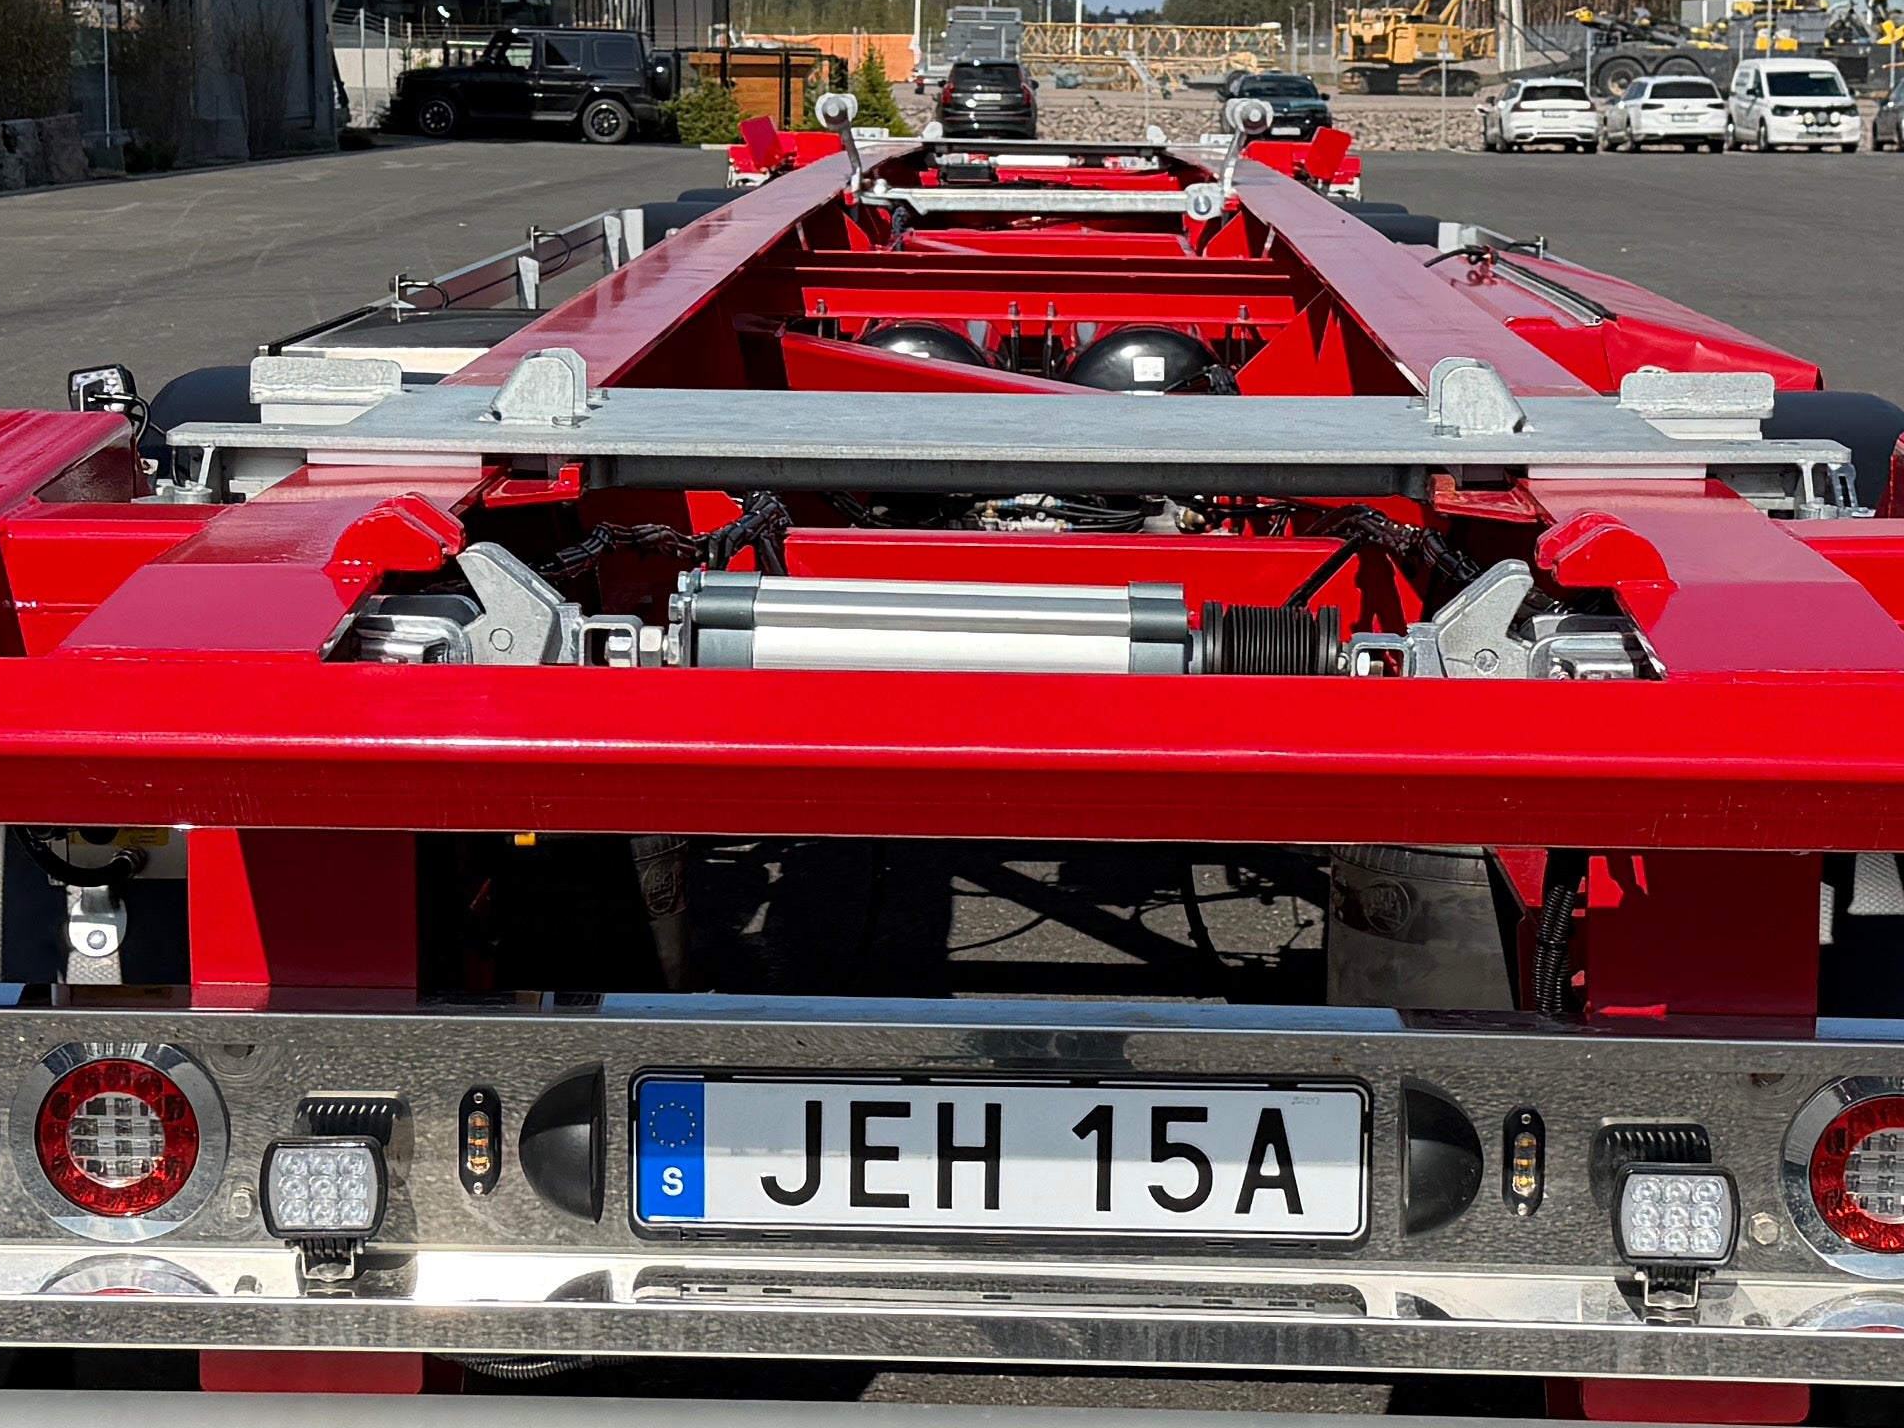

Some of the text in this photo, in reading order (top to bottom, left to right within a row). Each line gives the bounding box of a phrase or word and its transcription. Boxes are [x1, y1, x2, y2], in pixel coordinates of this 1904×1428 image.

[660, 1166, 685, 1197] S
[759, 1100, 1304, 1215] JEH 15A
